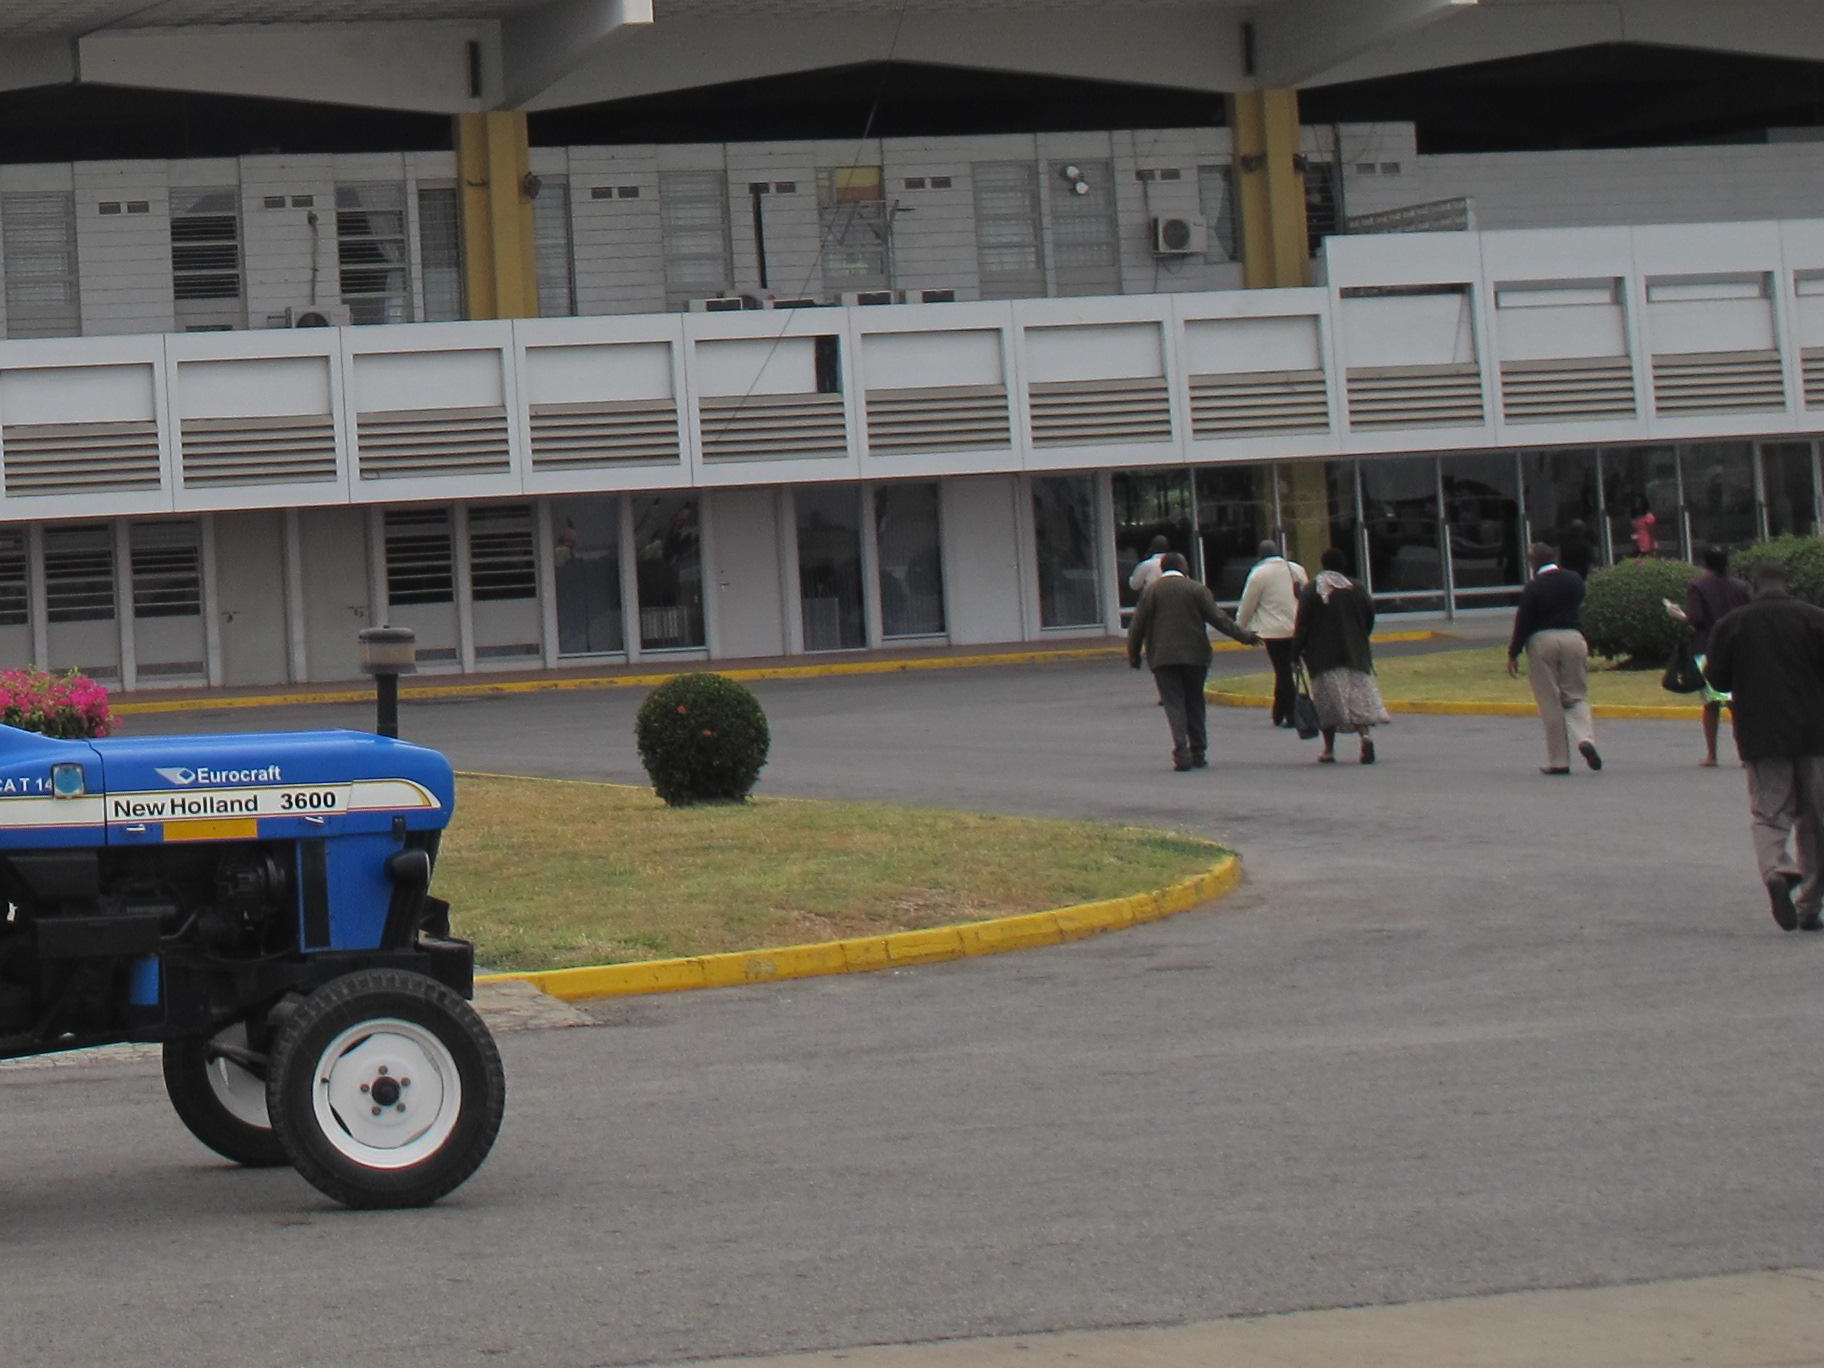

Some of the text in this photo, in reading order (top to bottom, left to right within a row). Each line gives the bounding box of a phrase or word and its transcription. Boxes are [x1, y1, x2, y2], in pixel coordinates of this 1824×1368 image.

[197, 765, 282, 783] Eurocraft
[114, 791, 337, 818] New Holland 3600
